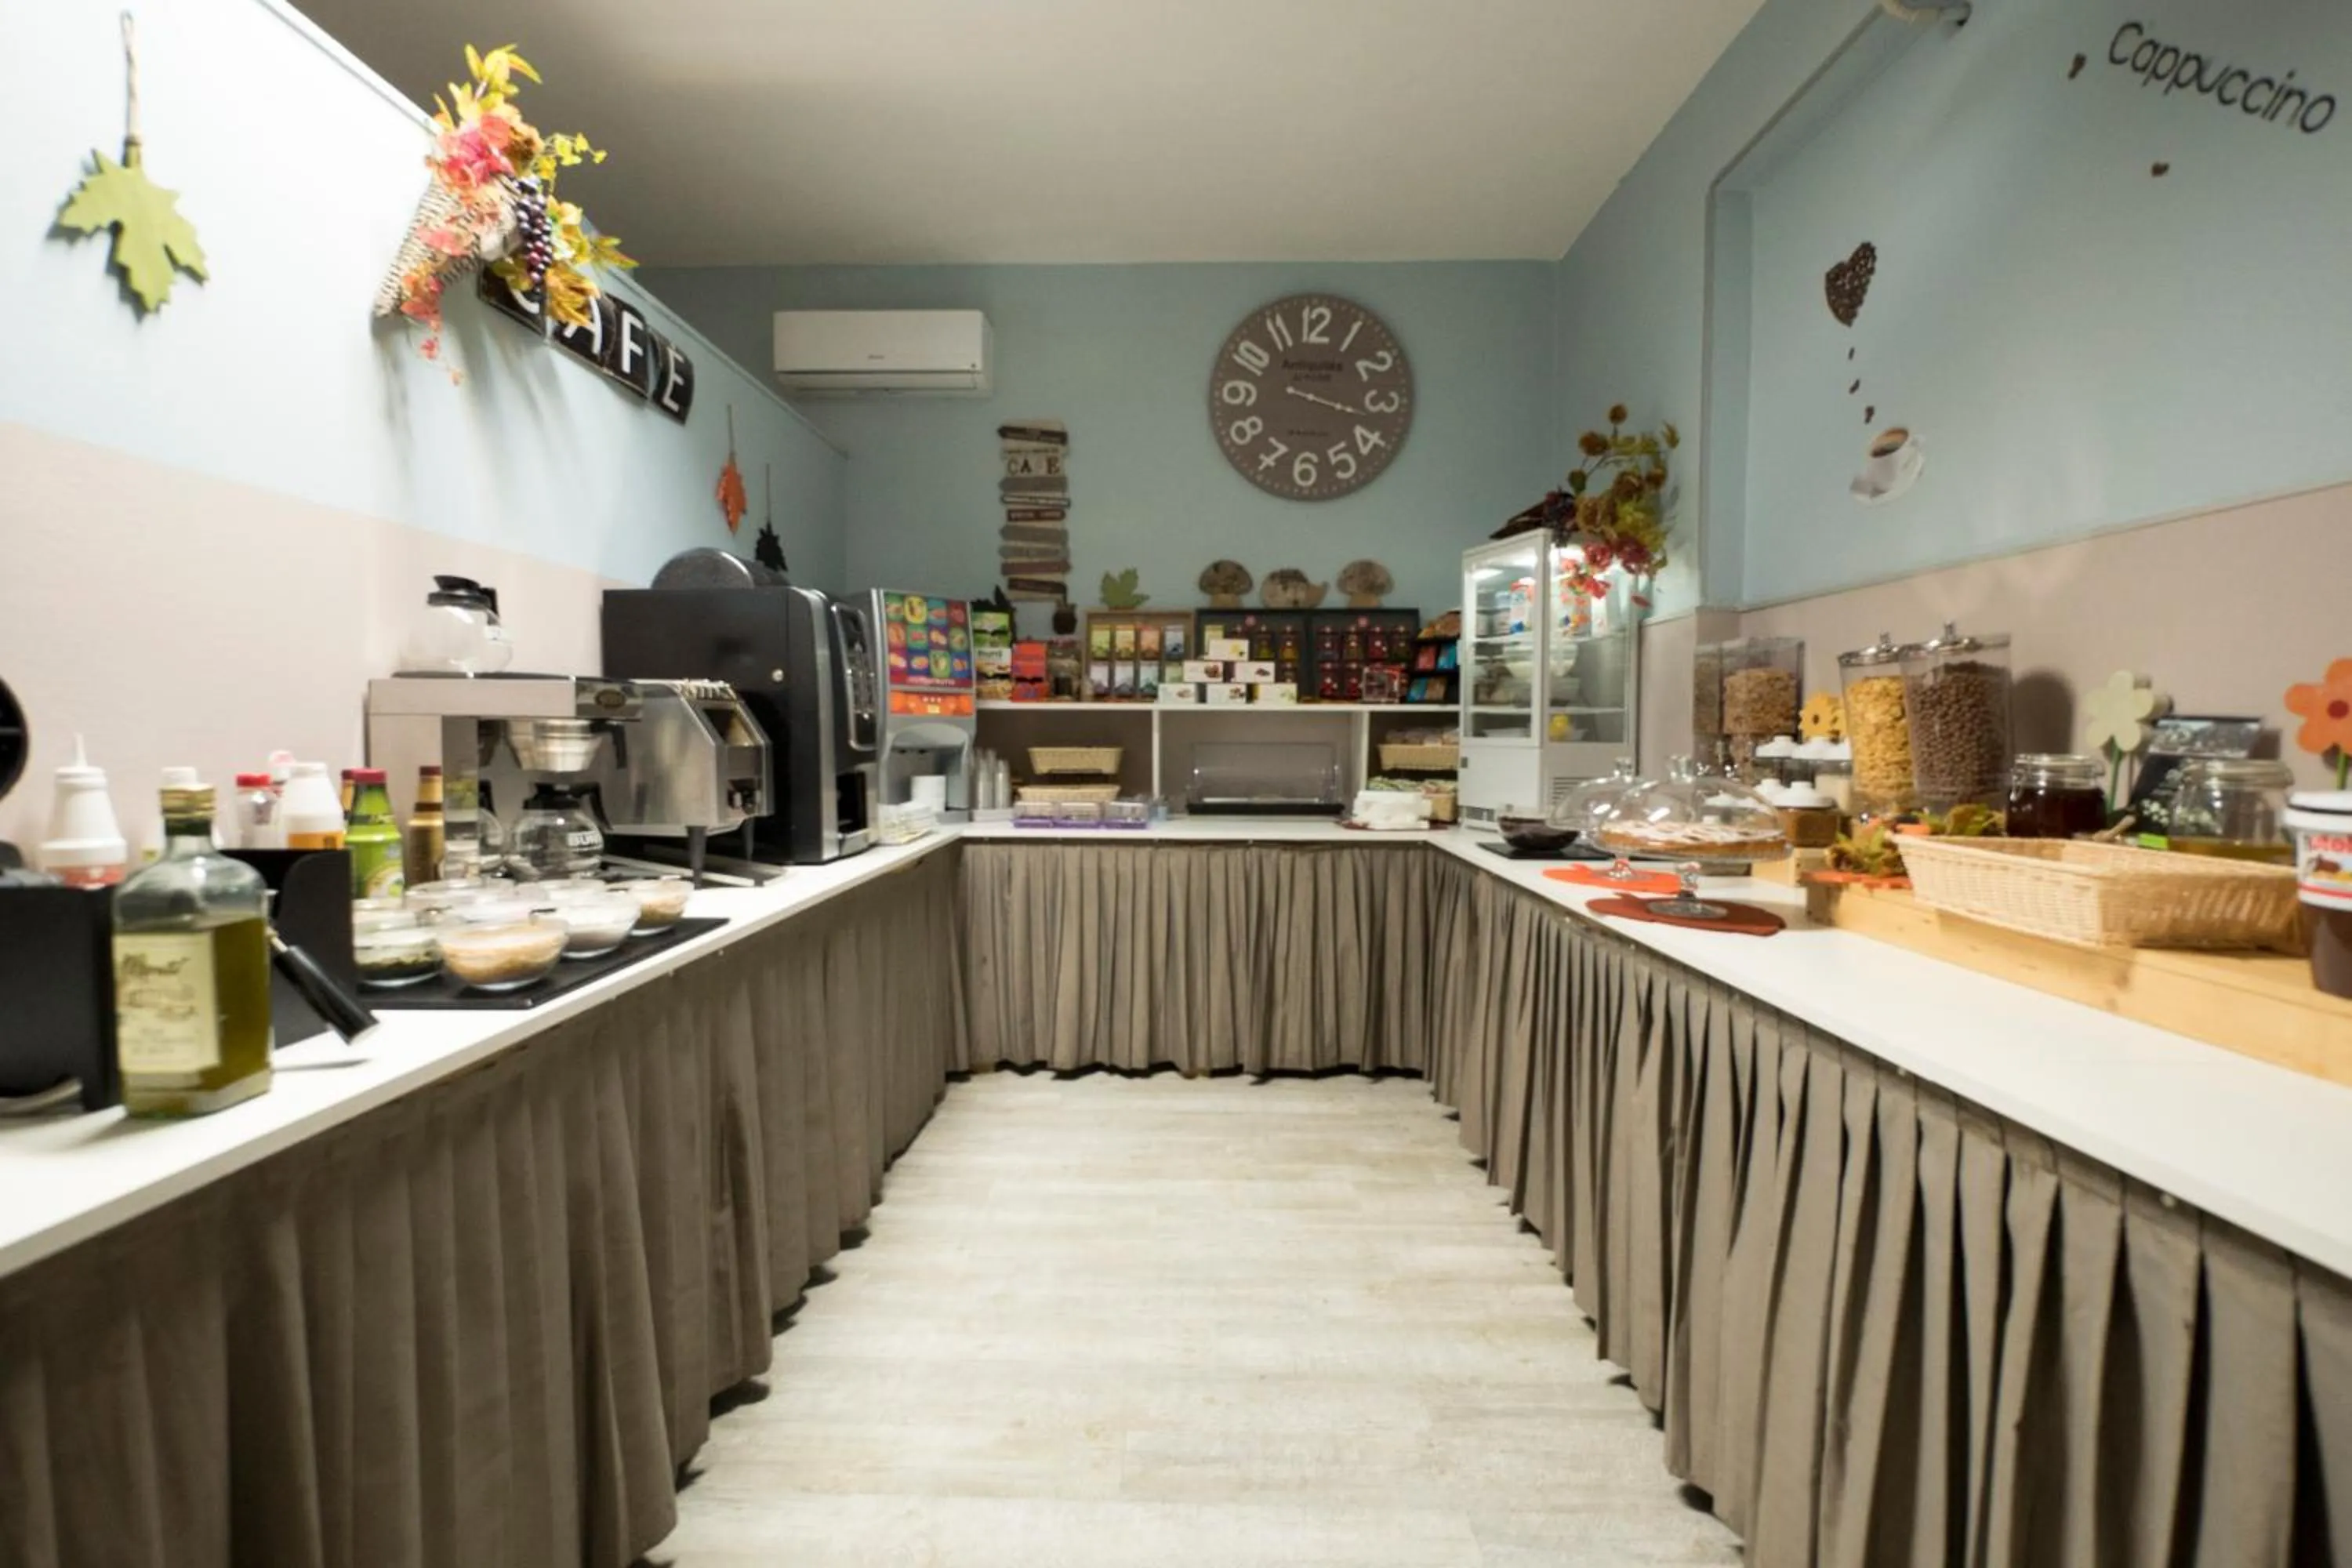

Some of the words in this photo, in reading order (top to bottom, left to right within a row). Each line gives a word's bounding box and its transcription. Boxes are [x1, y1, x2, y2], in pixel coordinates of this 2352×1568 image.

[2109, 22, 2336, 133] Cappuccino
[1265, 314, 1294, 352] 11
[1302, 306, 1331, 343] 12
[1339, 321, 1363, 352] 1
[1232, 339, 1270, 376] 10
[1355, 350, 1392, 382] 2
[1221, 380, 1258, 407] 9
[1364, 389, 1399, 414] 3
[1229, 416, 1263, 445] 8
[1354, 424, 1386, 456] 4
[1258, 437, 1290, 471] 7
[1293, 452, 1319, 487] 6
[1327, 441, 1356, 479] 5
